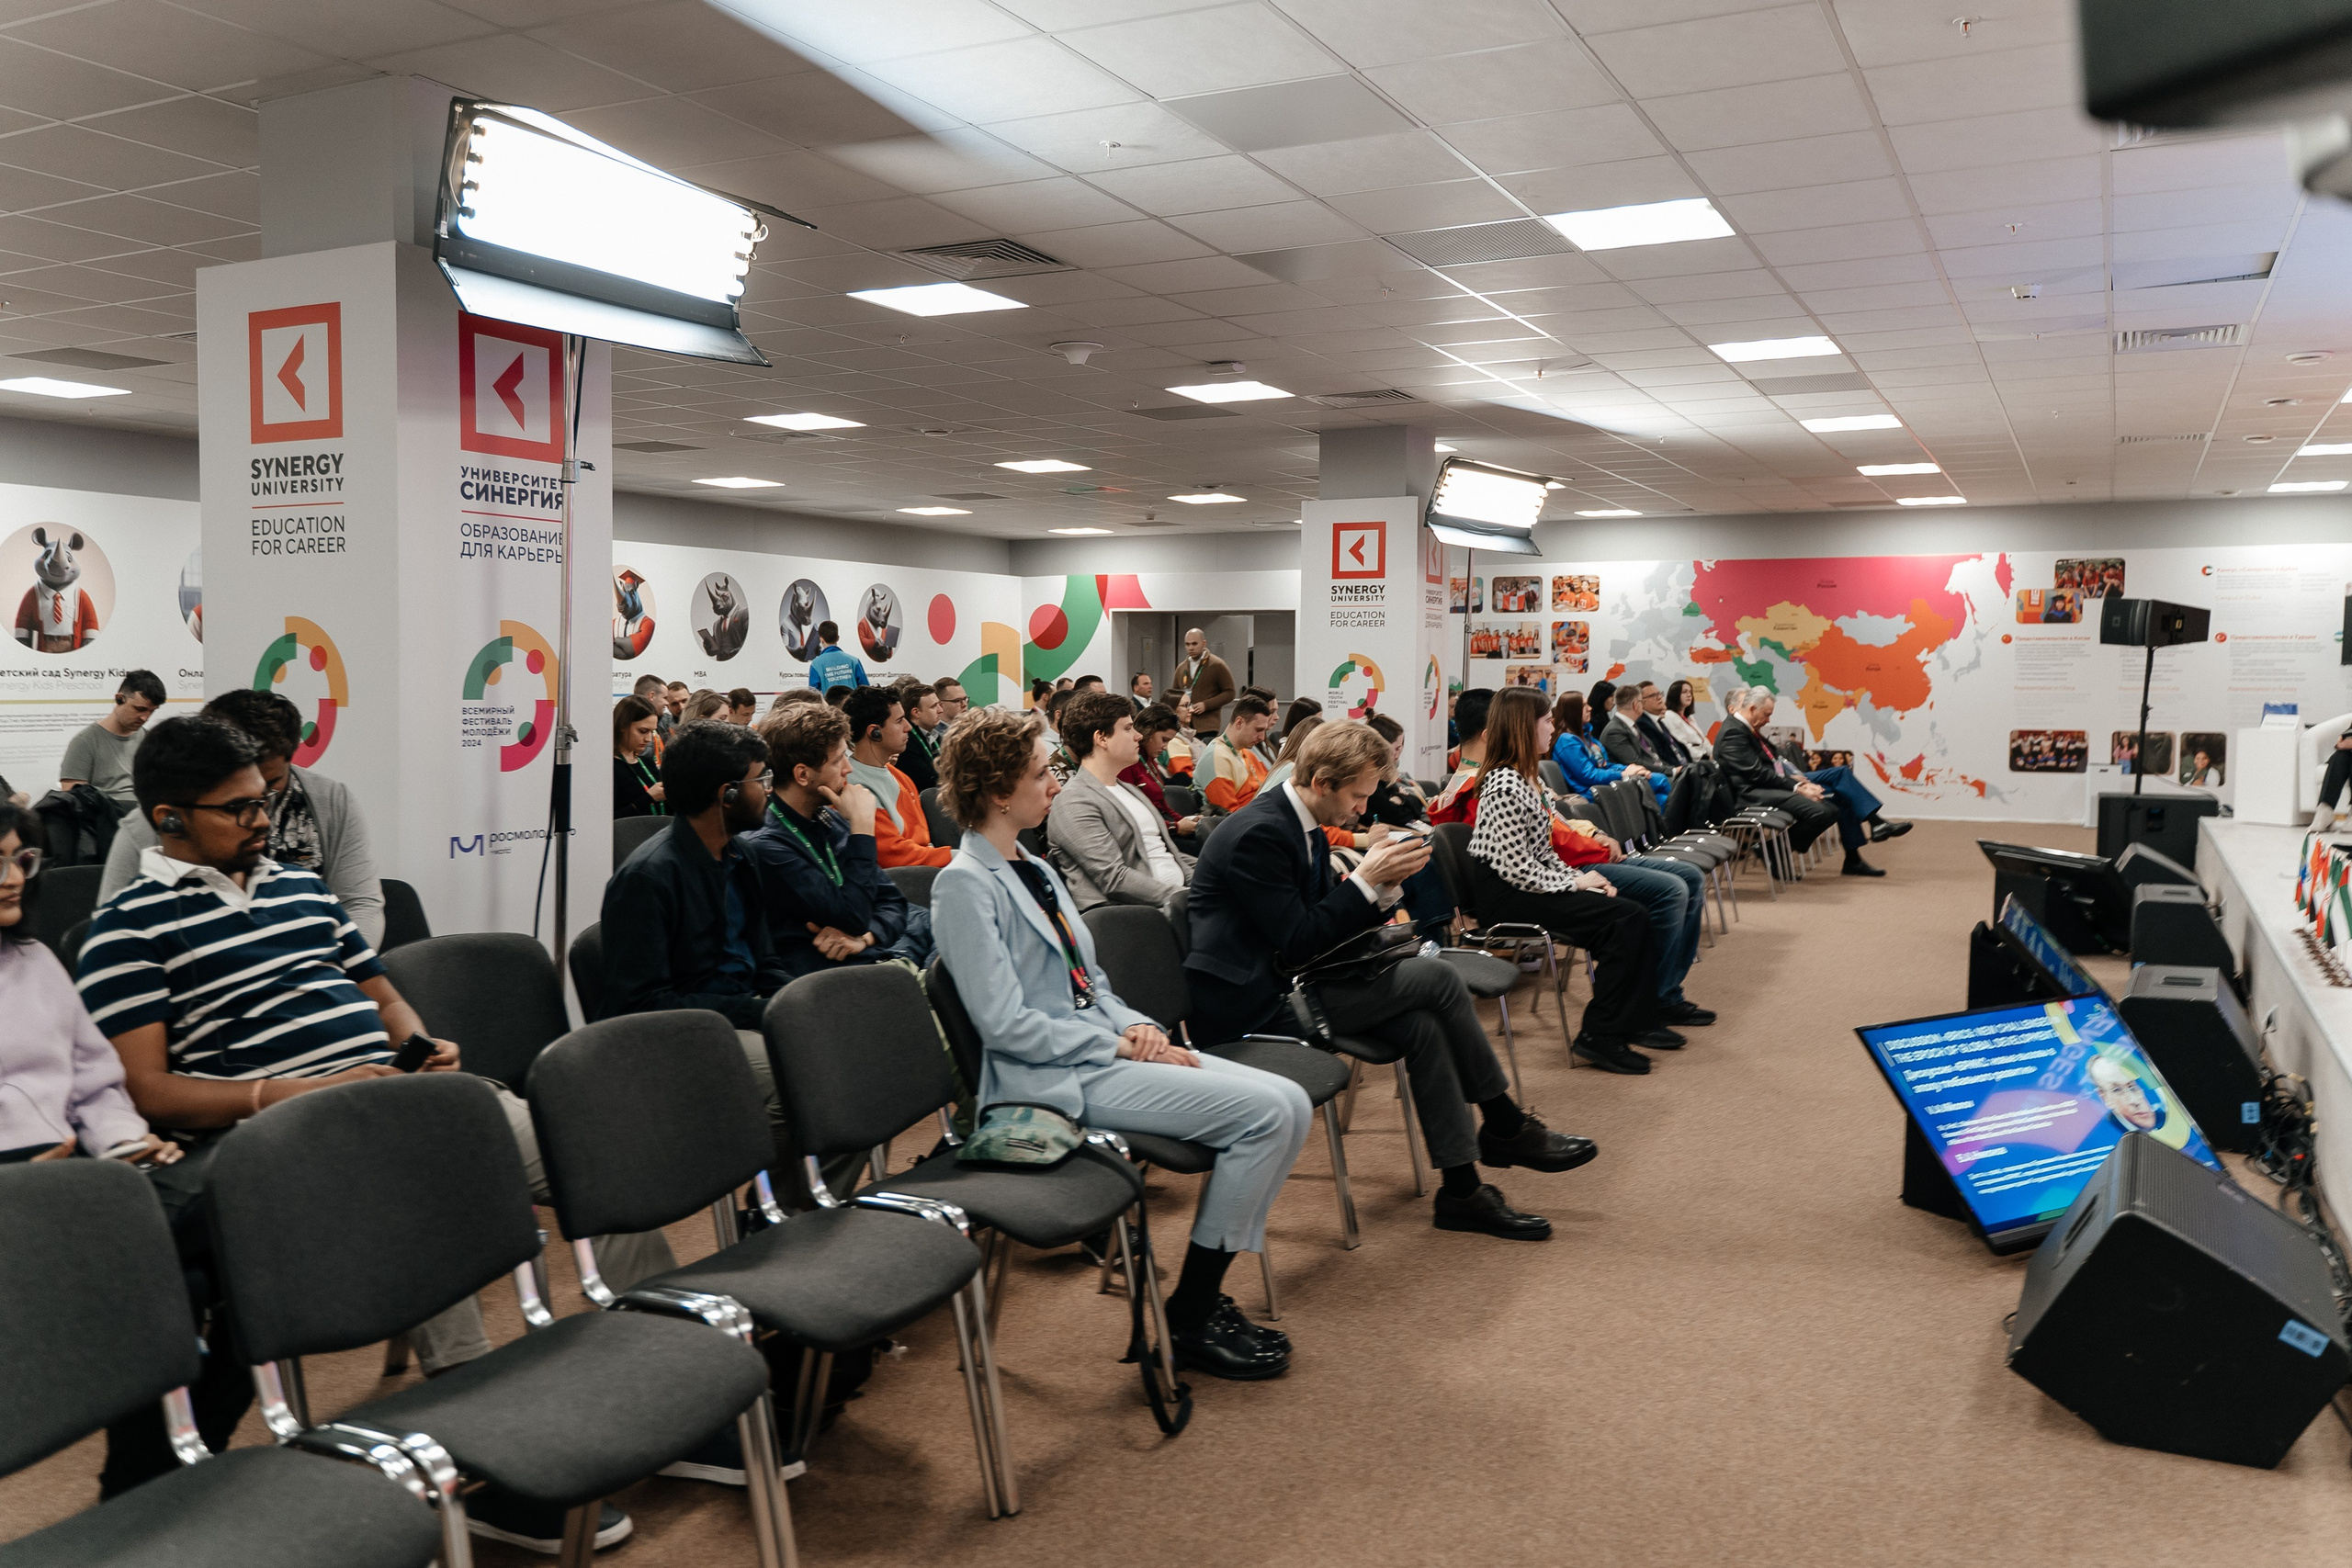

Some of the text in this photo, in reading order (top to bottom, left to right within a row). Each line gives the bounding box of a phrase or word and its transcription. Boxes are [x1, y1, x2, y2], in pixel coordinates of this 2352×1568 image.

[251, 453, 345, 479] SYNERGY
[251, 477, 345, 496] UNIVERSITY
[460, 480, 563, 510] СИНЕРГИЯ
[252, 515, 345, 536] EDUCATION
[252, 536, 346, 556] FOR CAREER
[460, 541, 492, 559] ДЛЯ
[1330, 584, 1385, 595] SYNERGY
[1330, 594, 1385, 603] UNIVERSITY
[1330, 611, 1385, 619] EDUCATION
[1350, 619, 1385, 627] CAREER
[825, 663, 849, 671] BUILDING
[0, 668, 40, 677] етский
[41, 670, 61, 679] сад
[63, 667, 106, 680] Synergy
[178, 668, 204, 678] Онла
[827, 674, 852, 682] TOGETHER
[462, 705, 515, 715] ВСЕМИРНЫЙ
[462, 717, 513, 726] ФЕСТИВАЛЬ
[461, 739, 482, 748] 2024
